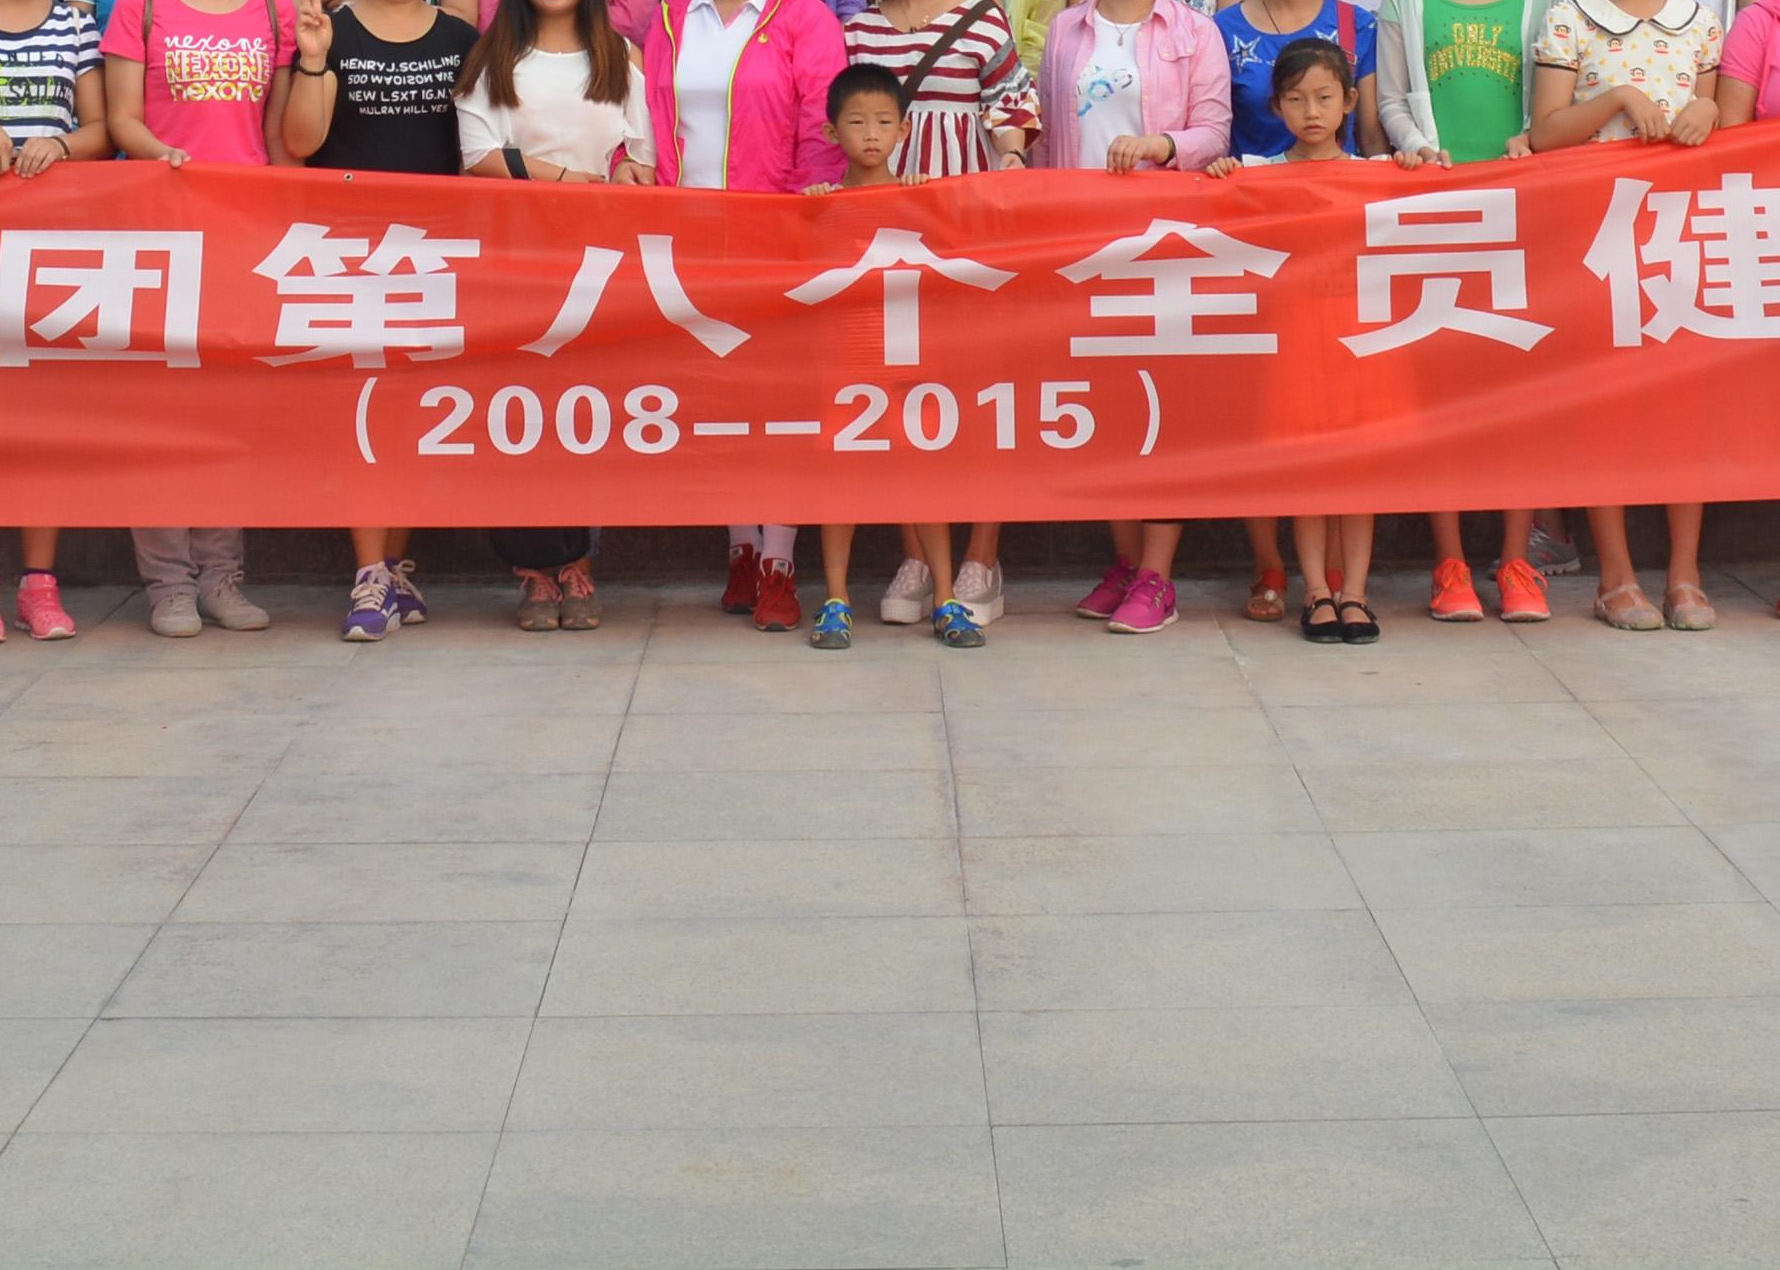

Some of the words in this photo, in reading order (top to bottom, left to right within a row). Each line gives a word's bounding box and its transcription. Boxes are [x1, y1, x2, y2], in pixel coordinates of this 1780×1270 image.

[1452, 23, 1502, 46] ONLY
[164, 35, 267, 54] nexone
[165, 50, 270, 84] NEXONE
[340, 57, 385, 71] HENRY
[171, 82, 264, 103] nexone
[348, 91, 376, 101] NEW
[403, 104, 428, 114] HILL
